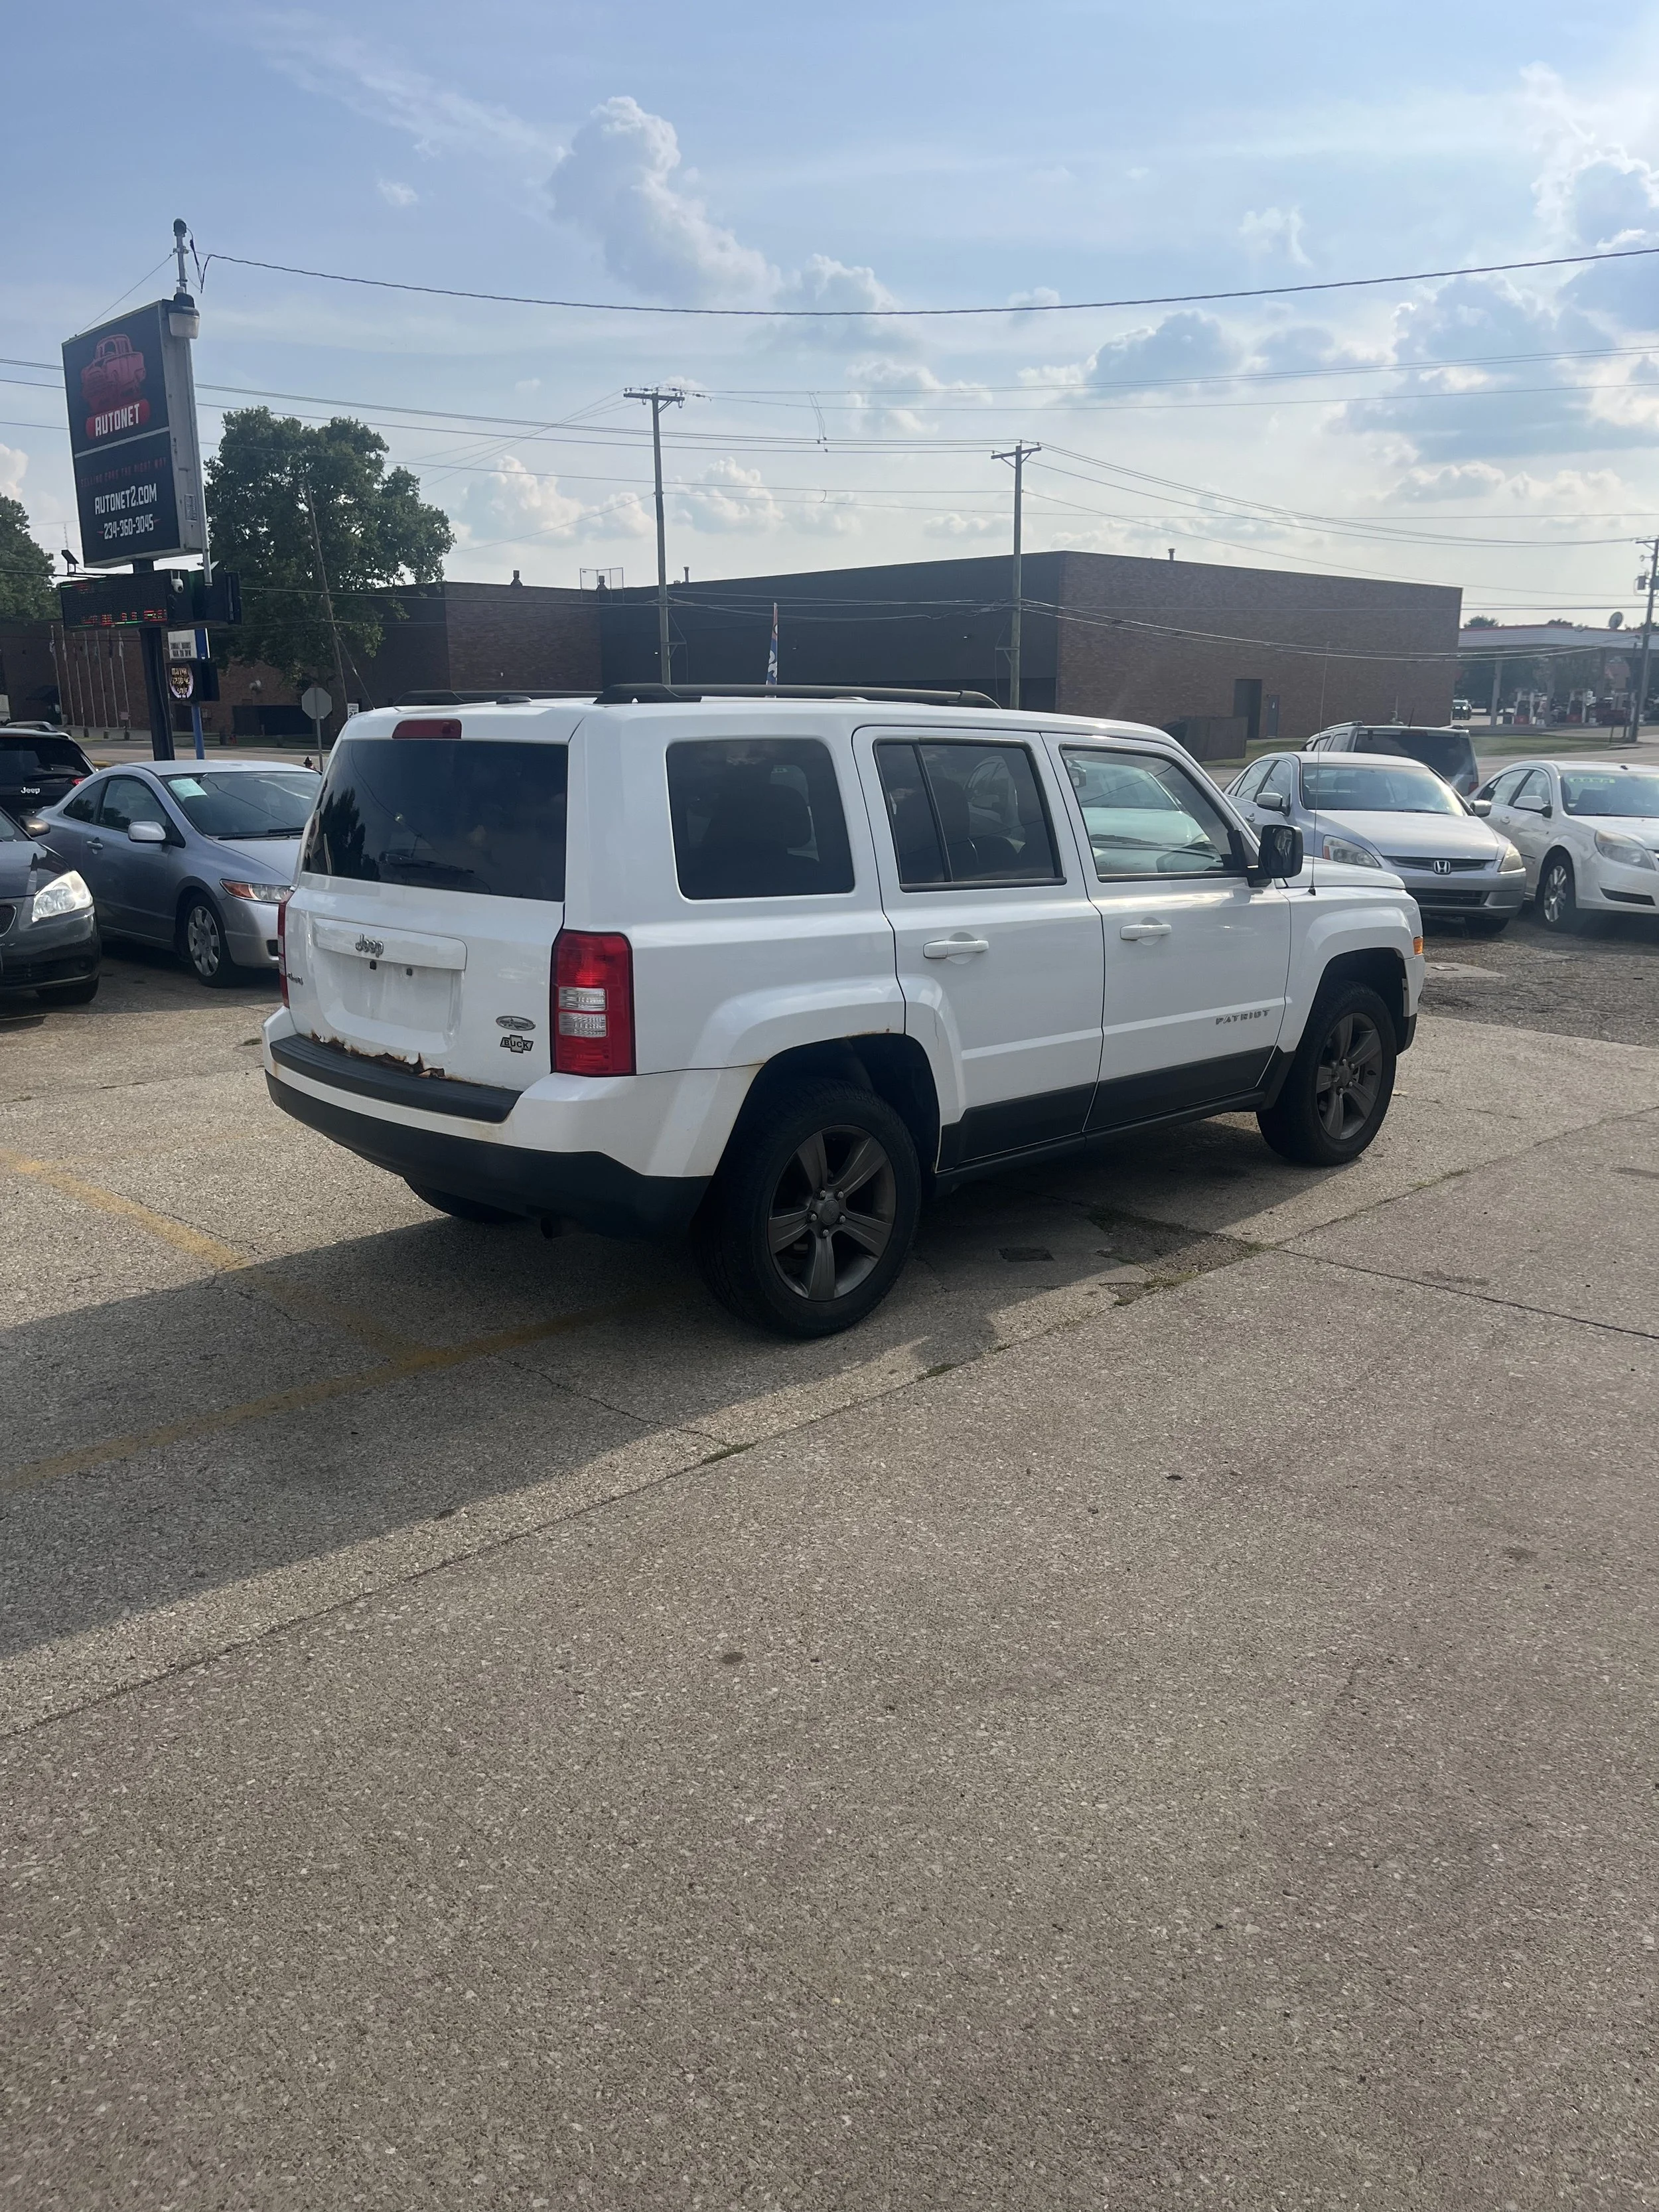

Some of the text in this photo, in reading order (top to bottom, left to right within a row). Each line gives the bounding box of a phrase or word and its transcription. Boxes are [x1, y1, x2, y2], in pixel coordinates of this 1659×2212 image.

[95, 403, 140, 437] AUTONET
[95, 483, 157, 515] AUTONET2.COM
[104, 514, 154, 540] 234-360-3045
[355, 933, 384, 958] Jeep
[1216, 1009, 1270, 1025] PATRIOT
[504, 1039, 530, 1049] BUCK
